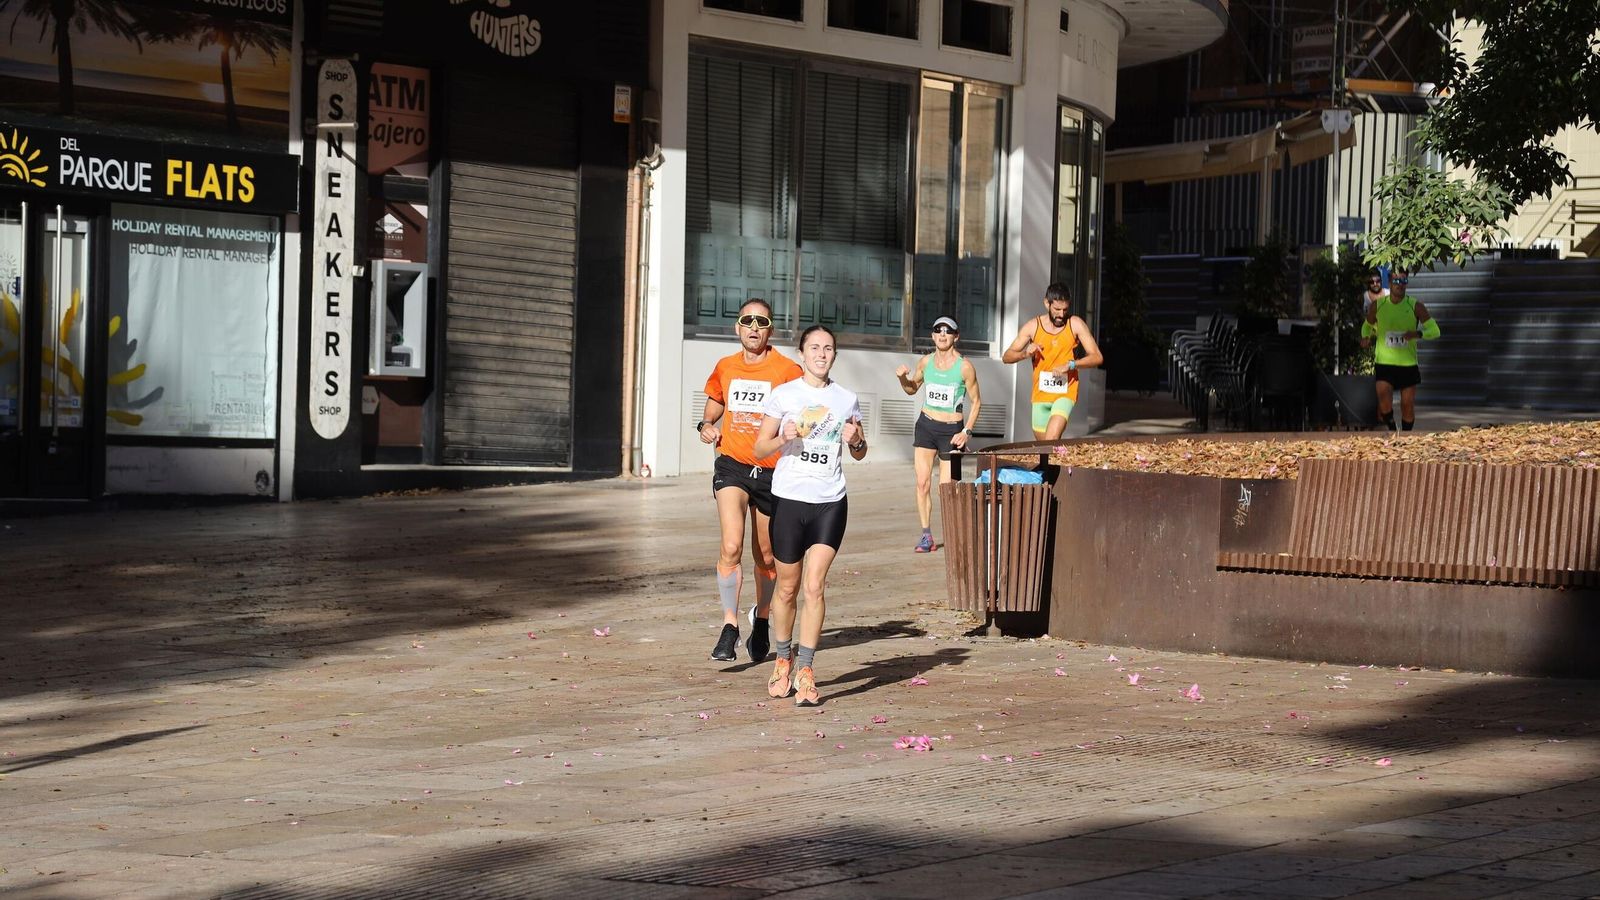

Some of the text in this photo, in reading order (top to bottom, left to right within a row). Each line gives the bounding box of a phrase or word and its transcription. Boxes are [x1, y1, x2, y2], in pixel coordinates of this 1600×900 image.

[194, 0, 287, 14] STICOS
[469, 10, 542, 57] HUNTERS
[325, 70, 348, 82] SHOP
[368, 73, 426, 112] ATM
[60, 137, 80, 151] DEL
[59, 154, 255, 203] PARQUE FLATS
[112, 219, 277, 243] HOLIDAY RENTAL MANAGEMENT
[130, 243, 178, 257] HOLIDAY
[182, 247, 220, 260] RENTAL
[324, 94, 344, 396] SNEAKERS
[1043, 379, 1063, 387] 334
[733, 391, 765, 402] 1737
[928, 391, 948, 401] 828
[319, 406, 341, 415] SHOP
[800, 451, 829, 465] 993
